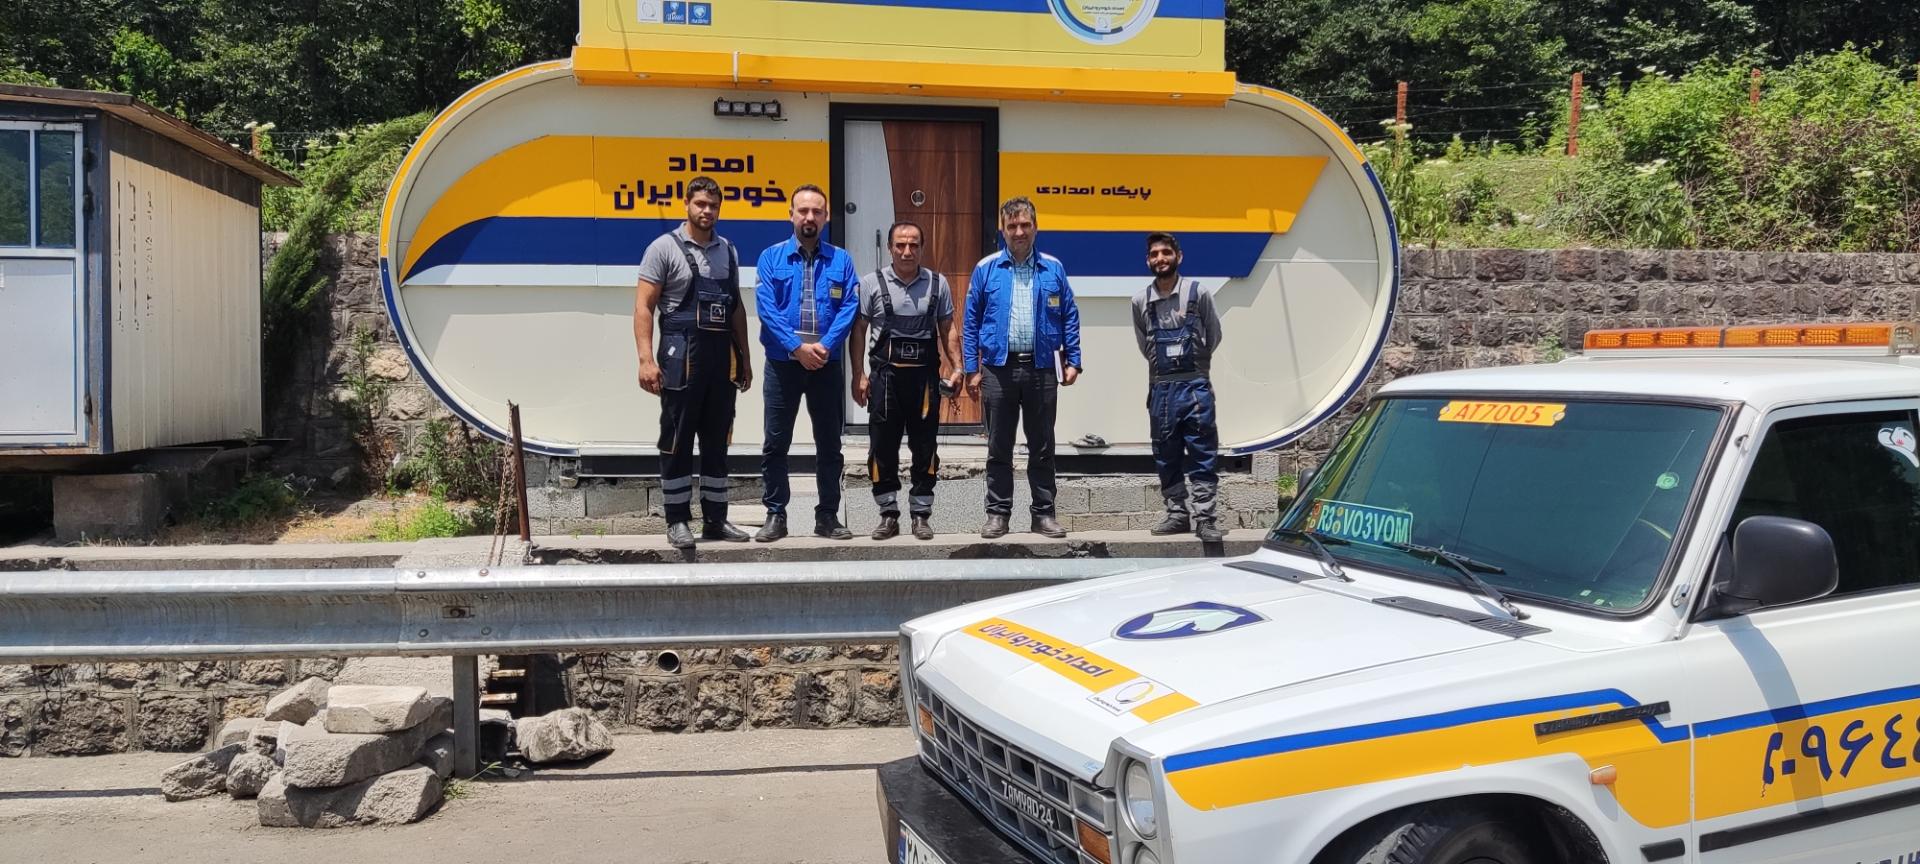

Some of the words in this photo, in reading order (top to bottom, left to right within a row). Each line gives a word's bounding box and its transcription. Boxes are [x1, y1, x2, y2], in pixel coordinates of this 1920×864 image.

[669, 153, 754, 173] امداد
[614, 180, 683, 210] ایران
[723, 180, 787, 207] خود
[1036, 185, 1095, 195] امدادی
[1101, 185, 1151, 200] پایگاه
[1453, 403, 1546, 423] AT7005
[978, 623, 1020, 642] ایران
[1012, 635, 1063, 657] خودرو
[1055, 651, 1113, 678] امداد
